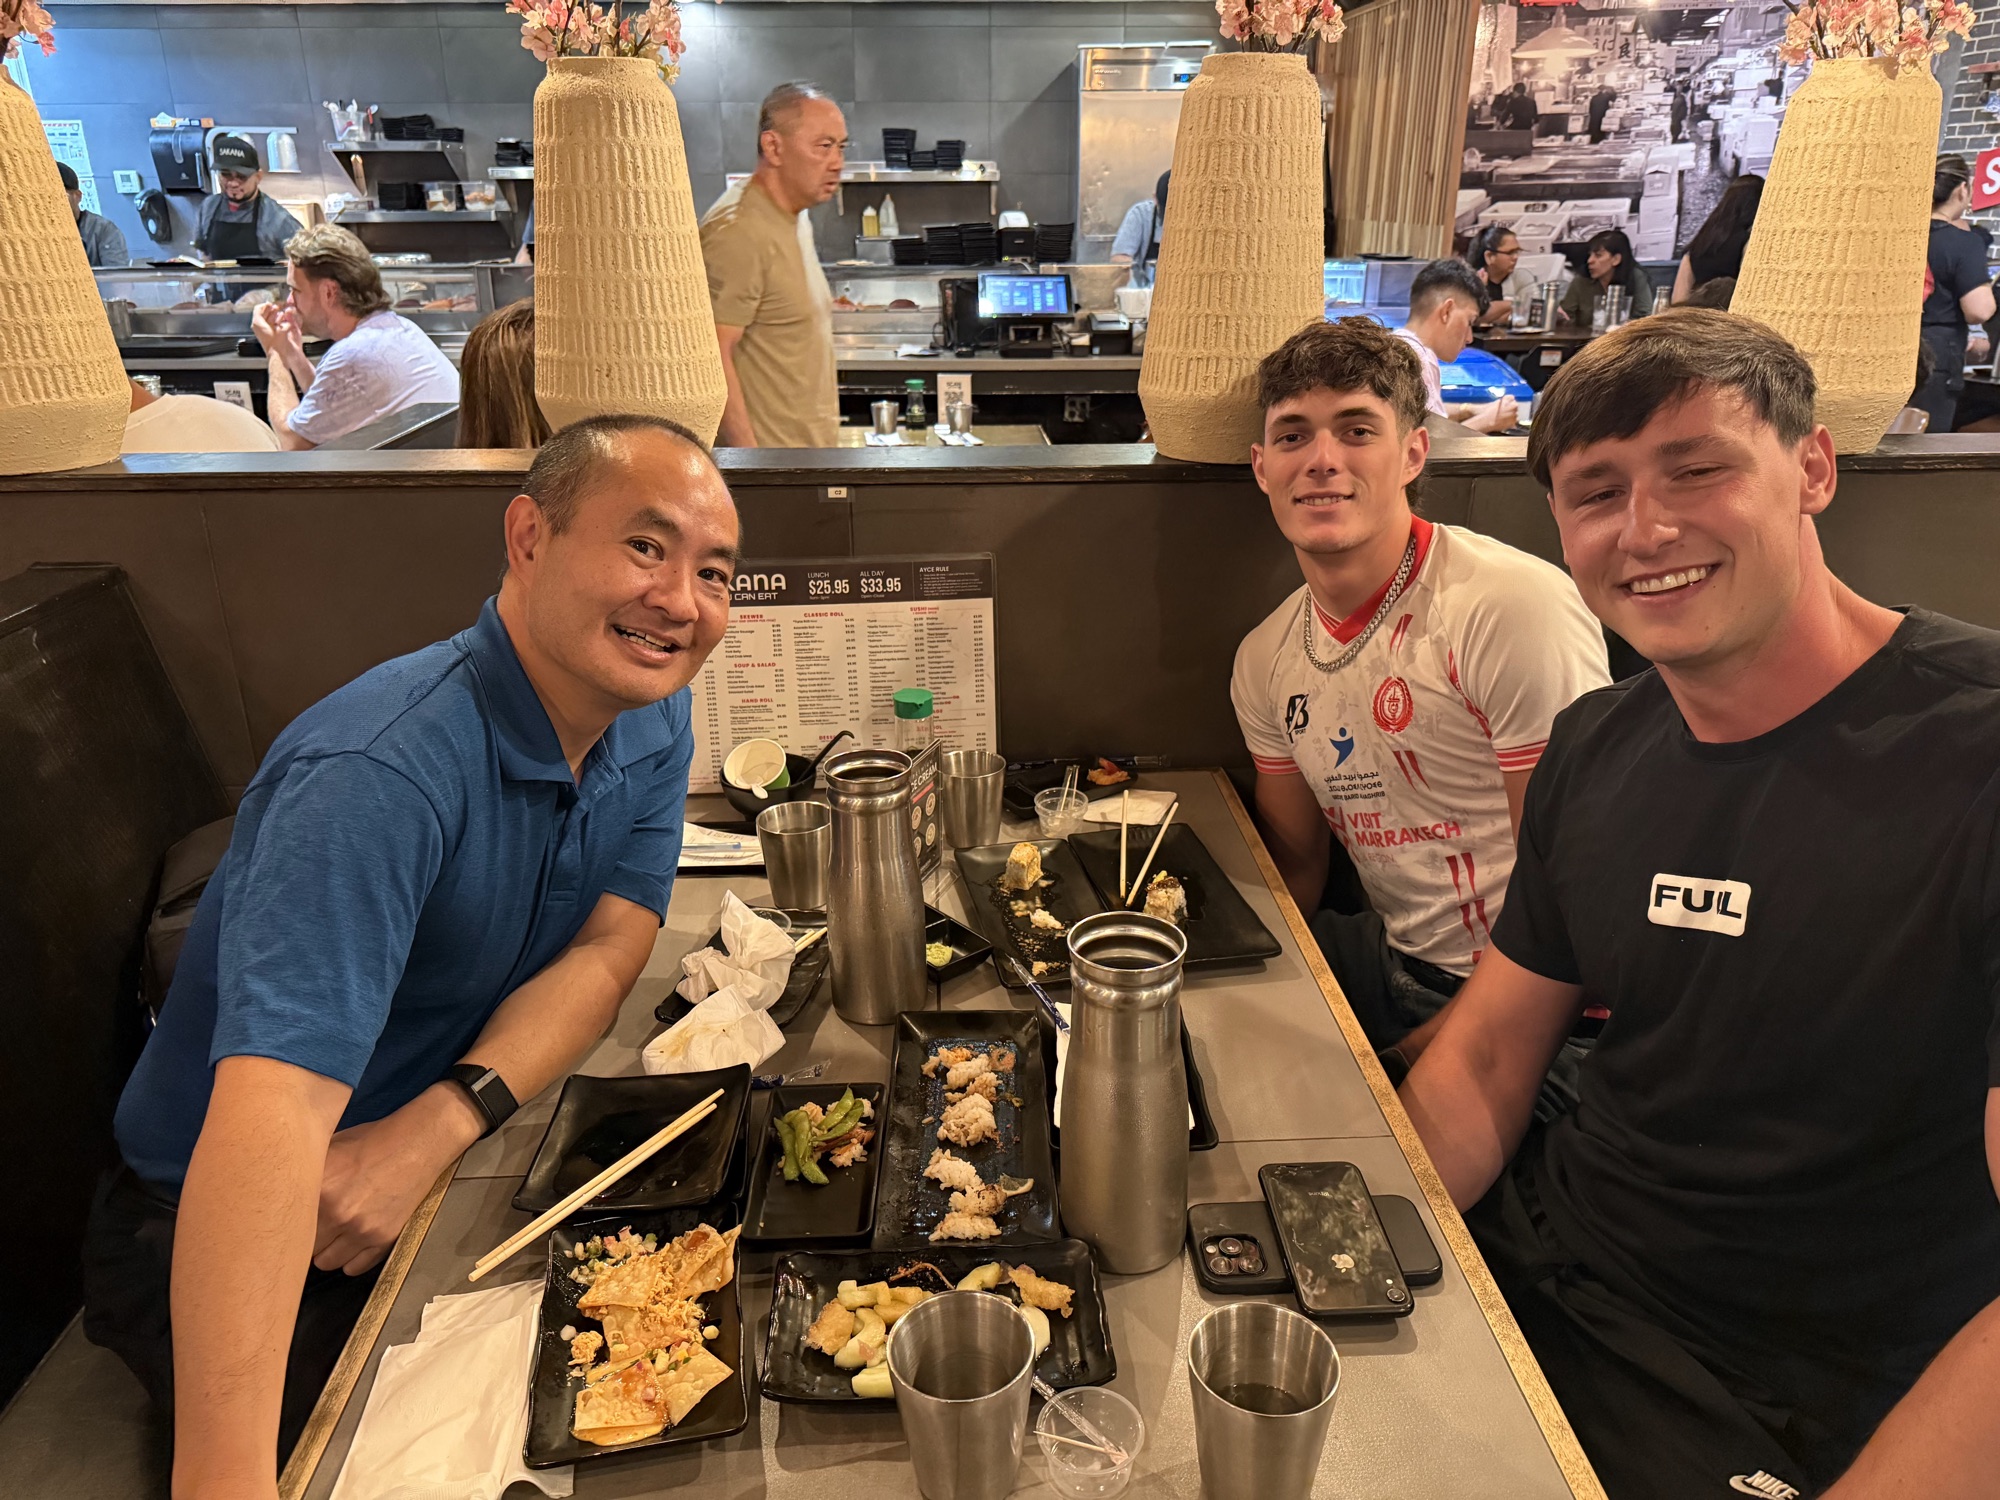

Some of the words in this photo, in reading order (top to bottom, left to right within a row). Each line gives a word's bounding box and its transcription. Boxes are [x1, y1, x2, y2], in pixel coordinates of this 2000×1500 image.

[219, 147, 246, 159] SAKANA
[807, 571, 830, 579] LUNCH
[808, 579, 850, 596] $25.95
[860, 577, 902, 594] $33.95
[734, 592, 756, 601] CAN
[757, 592, 779, 600] EAT
[917, 761, 938, 786] CREAM
[1347, 812, 1382, 830] VISIT
[1355, 818, 1462, 848] MARRAKECH
[1744, 1469, 1800, 1500] NIKE
